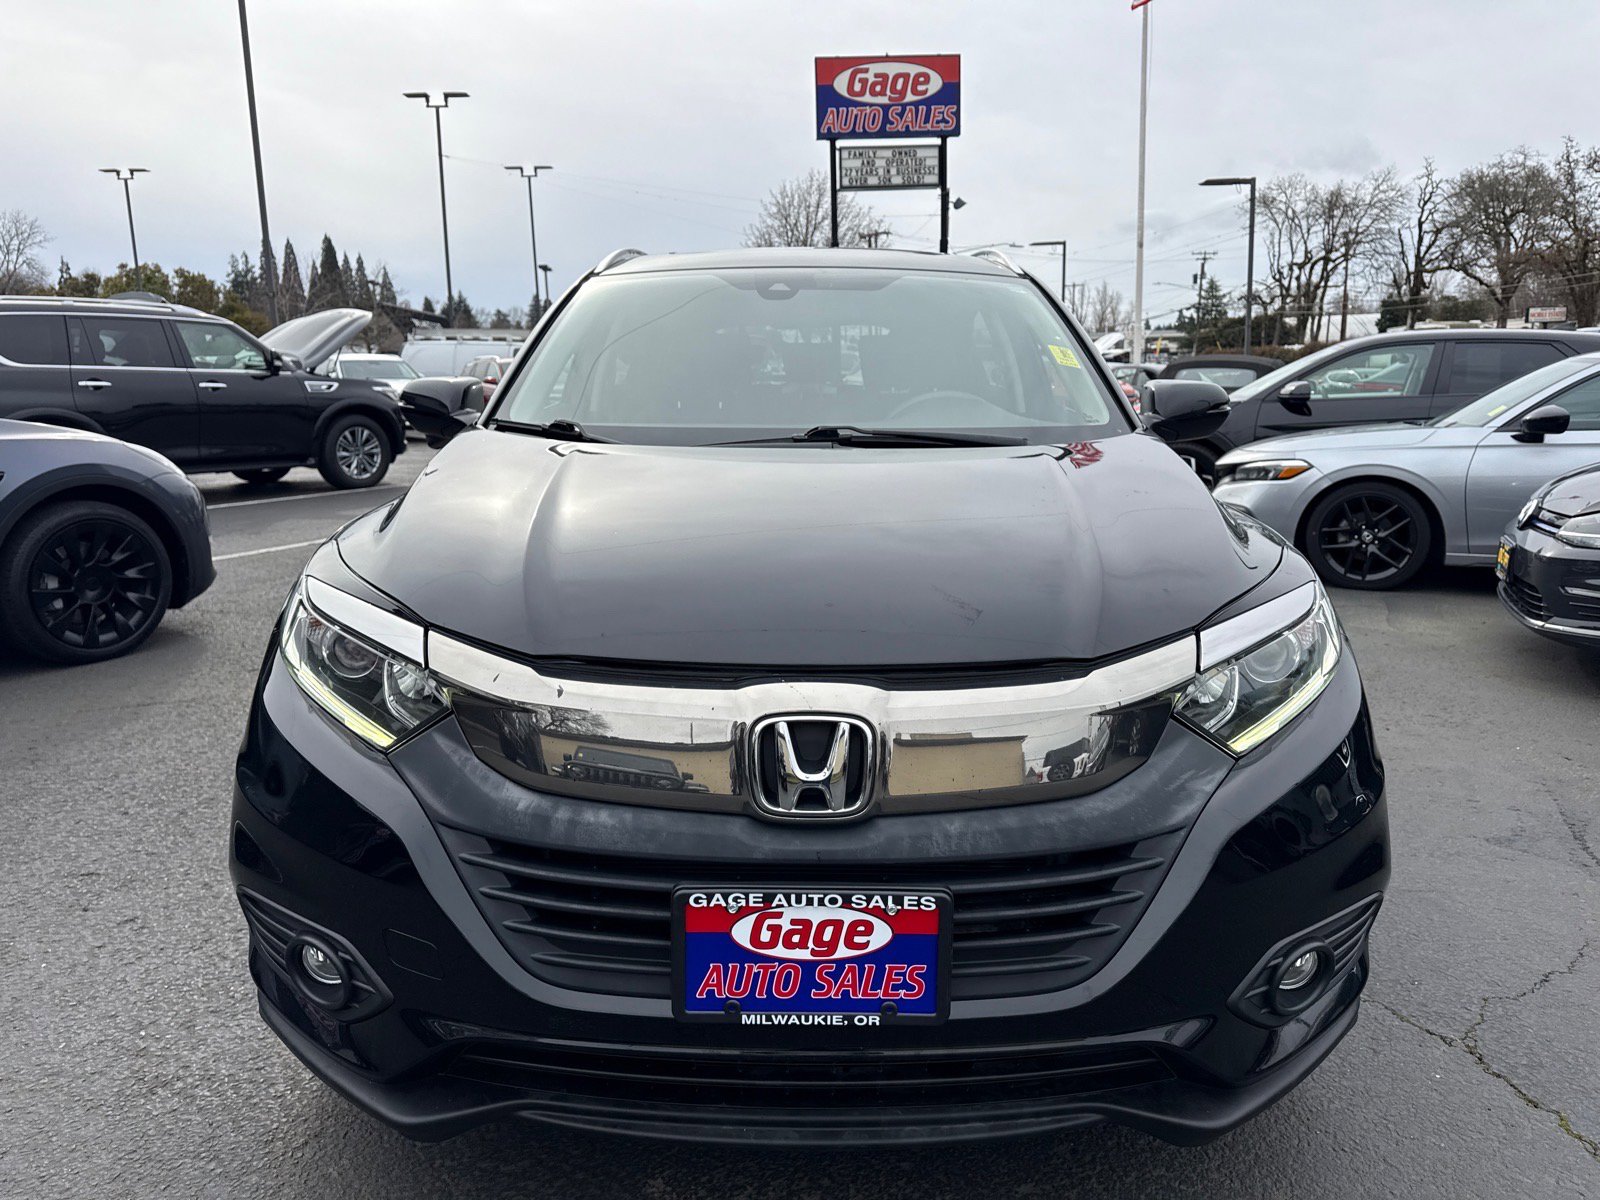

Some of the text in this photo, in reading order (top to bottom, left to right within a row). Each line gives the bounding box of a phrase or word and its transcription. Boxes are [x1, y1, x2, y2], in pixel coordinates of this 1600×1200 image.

[846, 67, 931, 103] Gage
[820, 104, 957, 134] AUTO SALES
[848, 149, 918, 159] FAMILY OWNED
[861, 159, 876, 167] AND
[855, 168, 879, 176] YEARS
[883, 168, 891, 176] IN
[848, 177, 869, 185] OVER
[688, 893, 937, 911] GAGE AUTO SALES
[749, 911, 875, 958] Gage
[696, 962, 928, 1000] AUTO SALES
[741, 1014, 881, 1027] MILWAUKIE, OR
